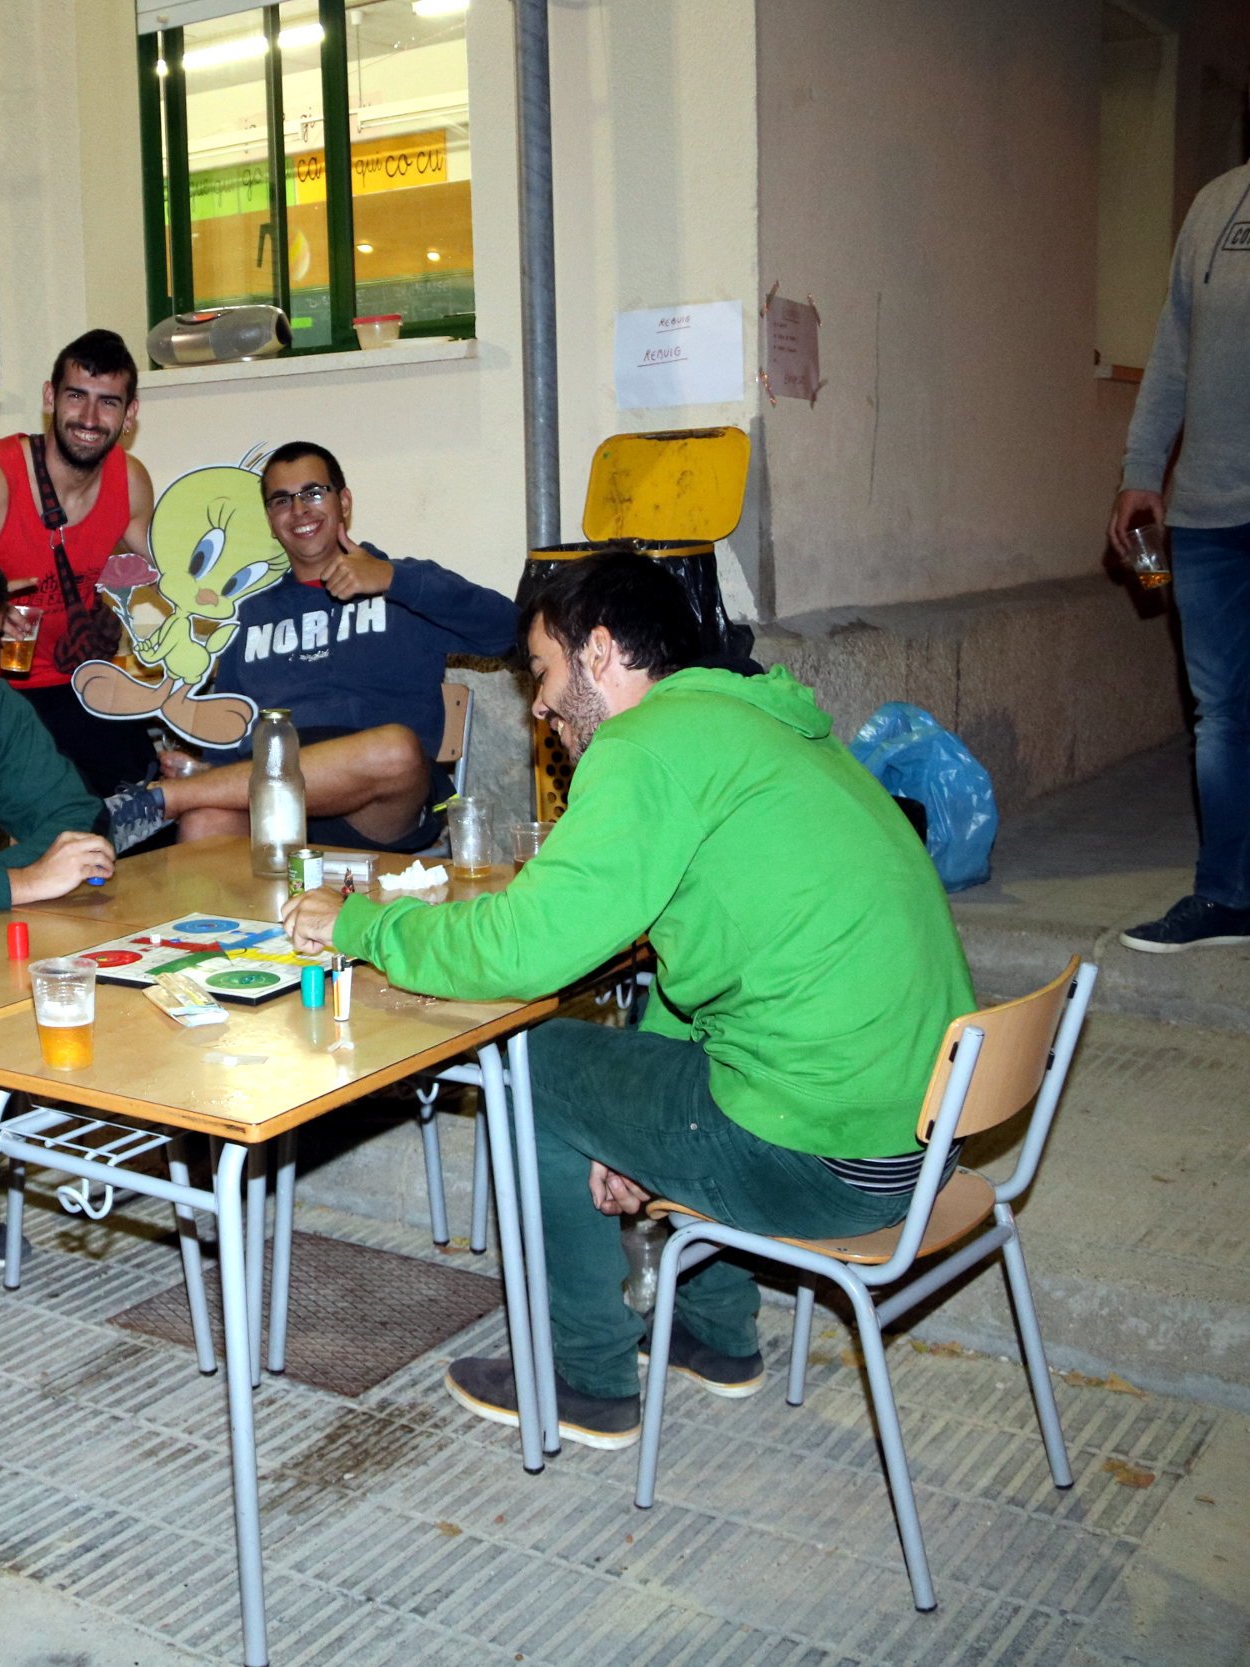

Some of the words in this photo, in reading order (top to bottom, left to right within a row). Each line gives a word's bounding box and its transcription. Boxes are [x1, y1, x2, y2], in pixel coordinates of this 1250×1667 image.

[1231, 227, 1250, 244] CO
[643, 346, 681, 362] REBUIG
[244, 596, 386, 663] NORTH
